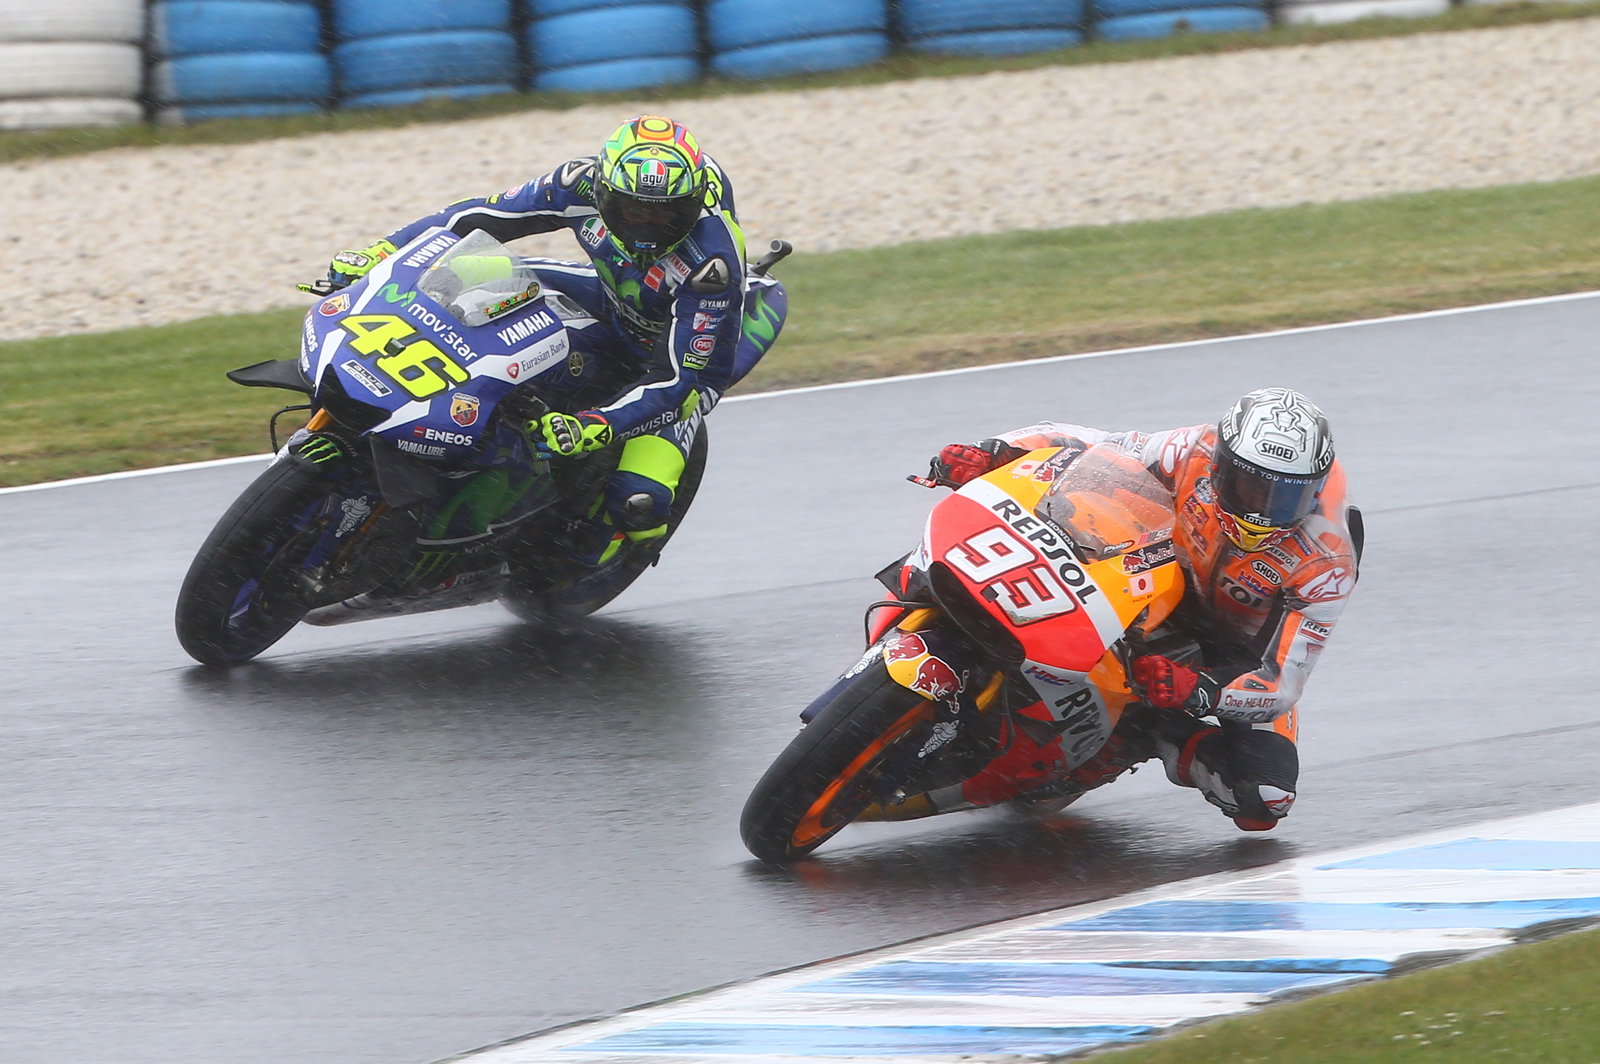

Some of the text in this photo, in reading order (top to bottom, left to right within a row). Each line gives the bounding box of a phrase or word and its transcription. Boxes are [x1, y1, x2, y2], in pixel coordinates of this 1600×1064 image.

[642, 173, 665, 185] agv
[581, 227, 601, 246] agv
[402, 234, 458, 268] YAMAHA
[305, 314, 319, 352] ENEOS
[407, 303, 478, 361] movistar
[497, 311, 555, 346] YAMAHA
[339, 313, 470, 398] 46
[521, 341, 566, 371] Eurasian Bank
[615, 408, 679, 440] movistar
[397, 439, 447, 457] YAMALUBE
[425, 429, 474, 447] ENEOS
[1260, 442, 1294, 460] SHOEI
[1233, 459, 1256, 474] GIVES
[1261, 471, 1279, 482] YOU
[1244, 514, 1271, 527] LOTUS
[1046, 519, 1076, 549] HONDA
[992, 498, 1099, 605] REPSOL
[1268, 546, 1297, 568] REPSOL
[945, 526, 1077, 626] 93
[1254, 562, 1279, 583] SHOEI
[1304, 620, 1329, 636] REP
[1225, 694, 1279, 709] One HEART
